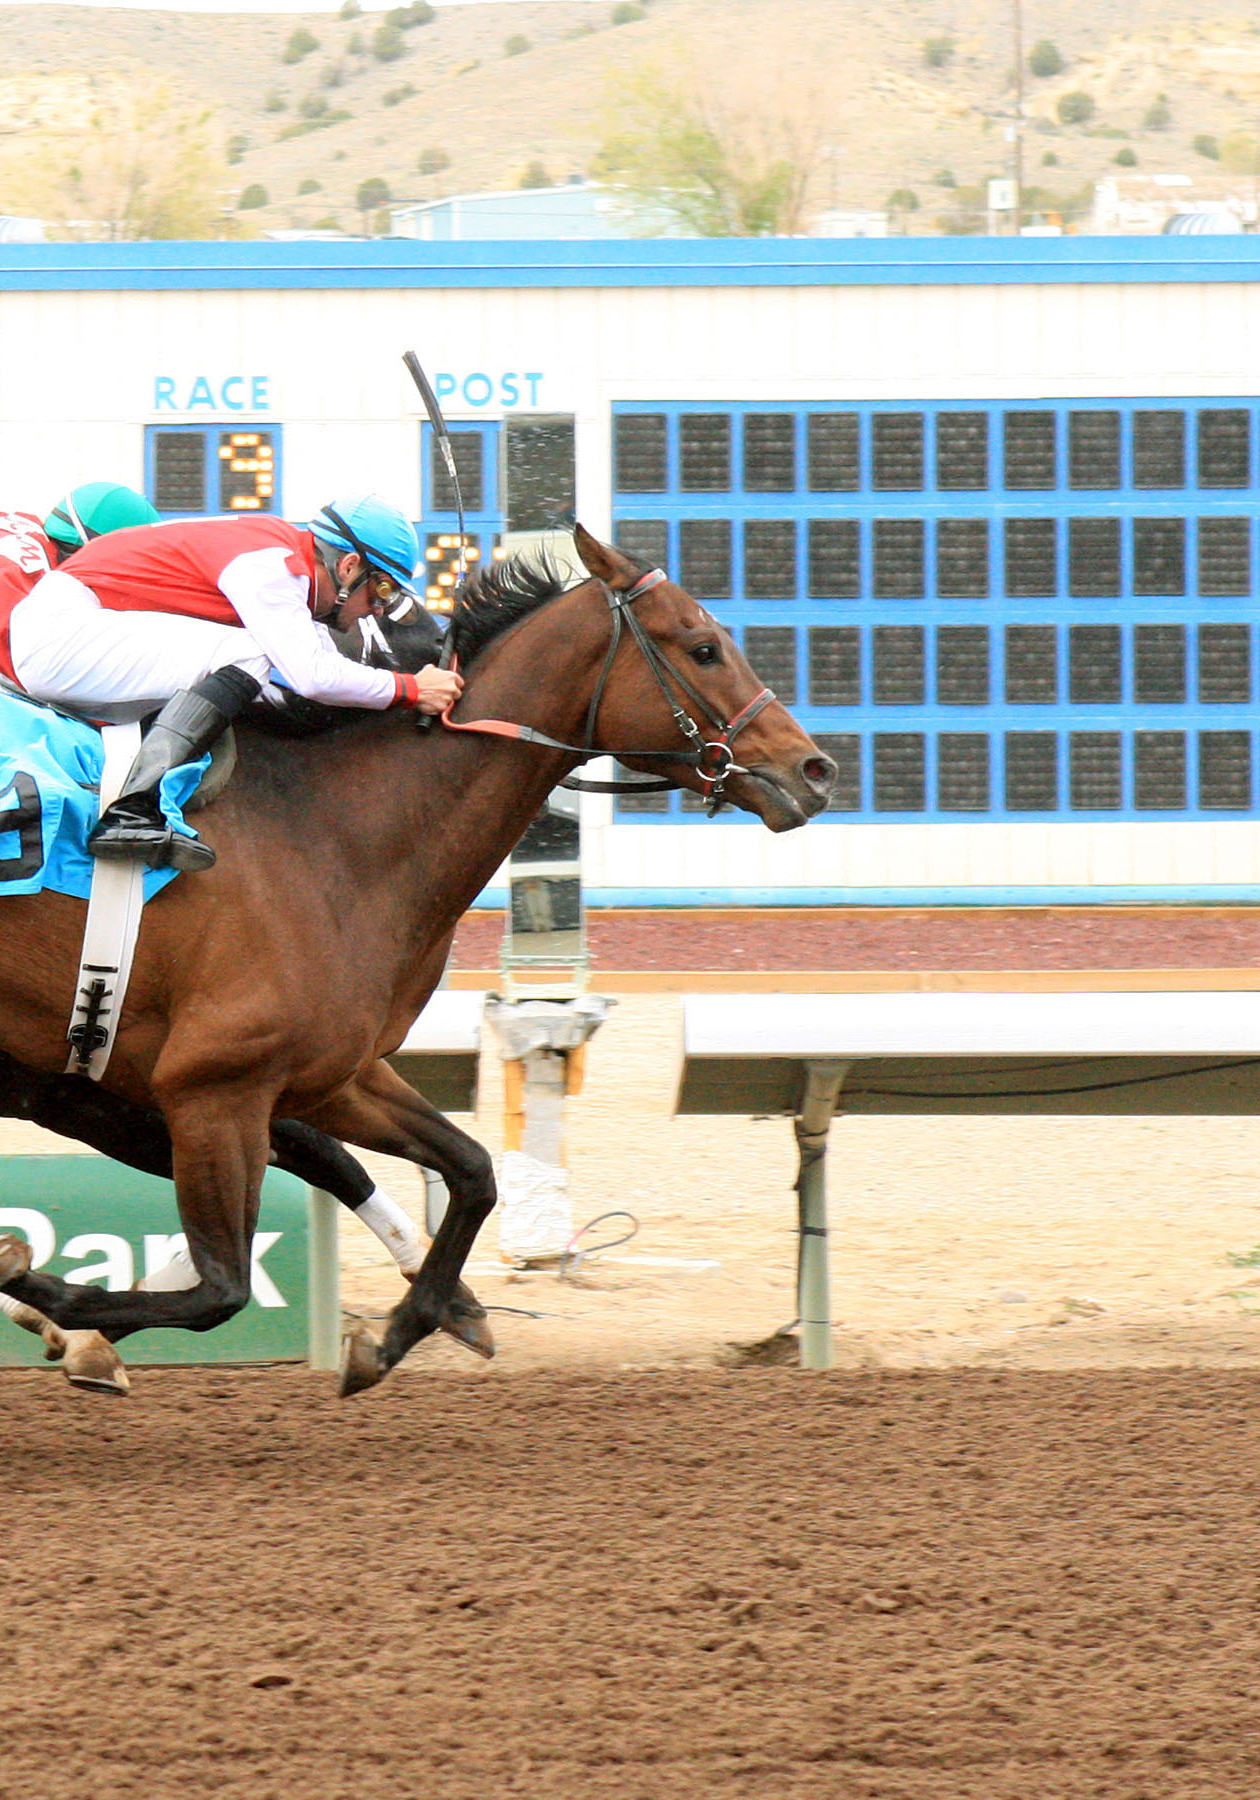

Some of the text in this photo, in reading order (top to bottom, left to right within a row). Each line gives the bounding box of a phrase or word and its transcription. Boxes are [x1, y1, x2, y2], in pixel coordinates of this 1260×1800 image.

[154, 375, 272, 411] RACE
[434, 372, 545, 407] POST
[218, 432, 275, 511] 9
